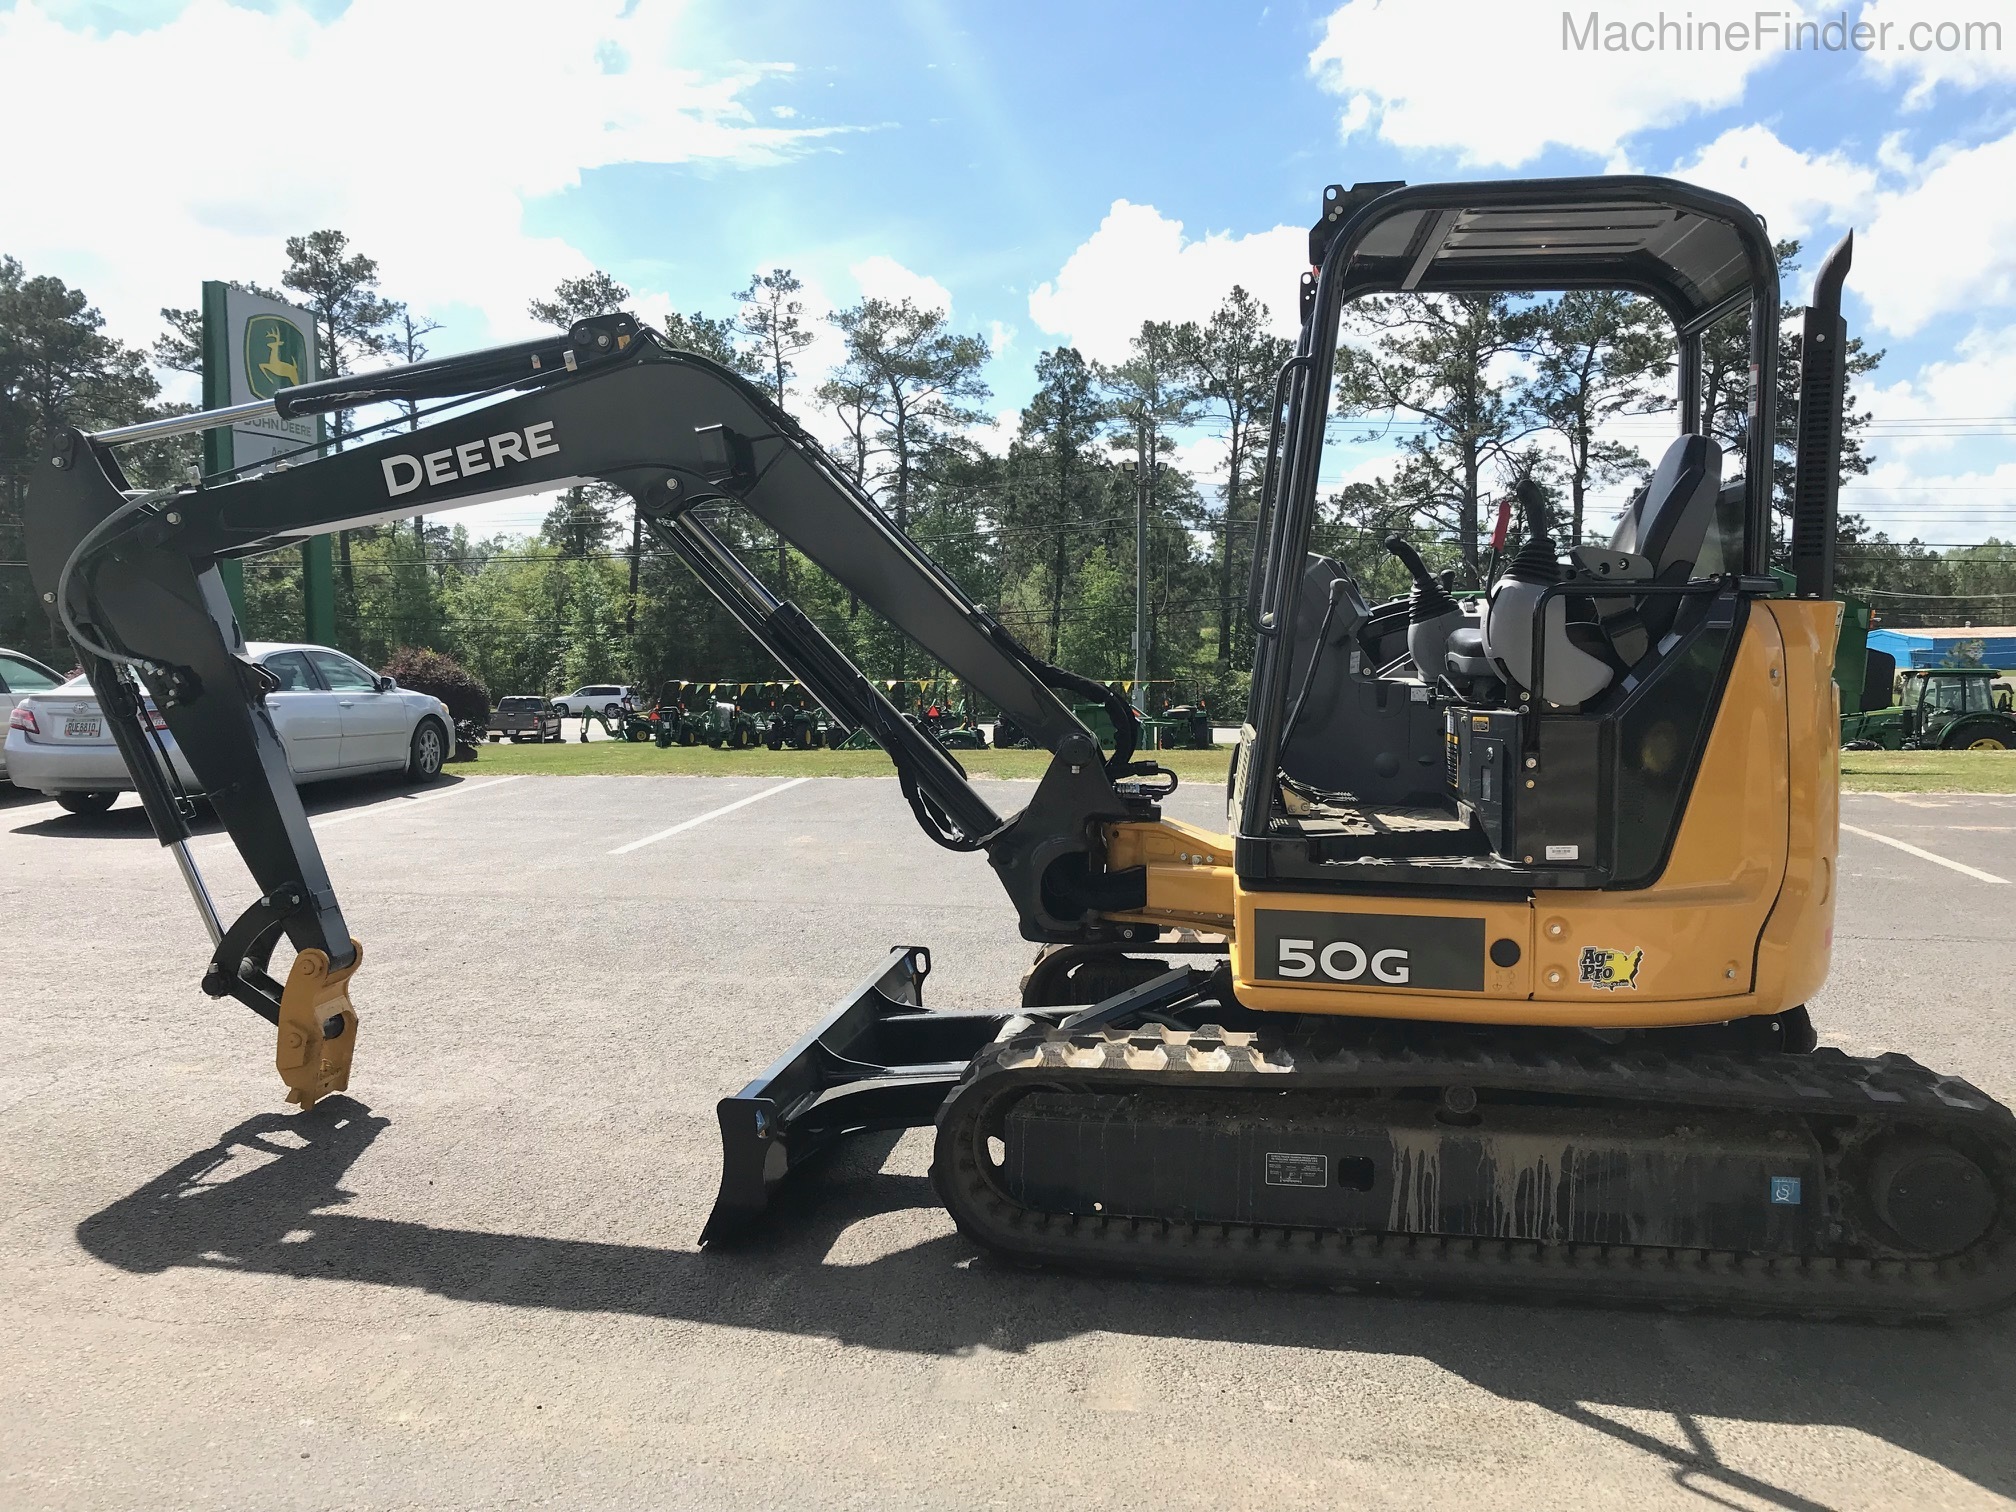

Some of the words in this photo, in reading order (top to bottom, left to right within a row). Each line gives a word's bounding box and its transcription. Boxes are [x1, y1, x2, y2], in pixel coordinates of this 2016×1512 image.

[281, 419, 312, 437] DEERE
[381, 420, 560, 497] DEERE
[1278, 938, 1409, 984] 50G
[1582, 965, 1613, 979] Pro
